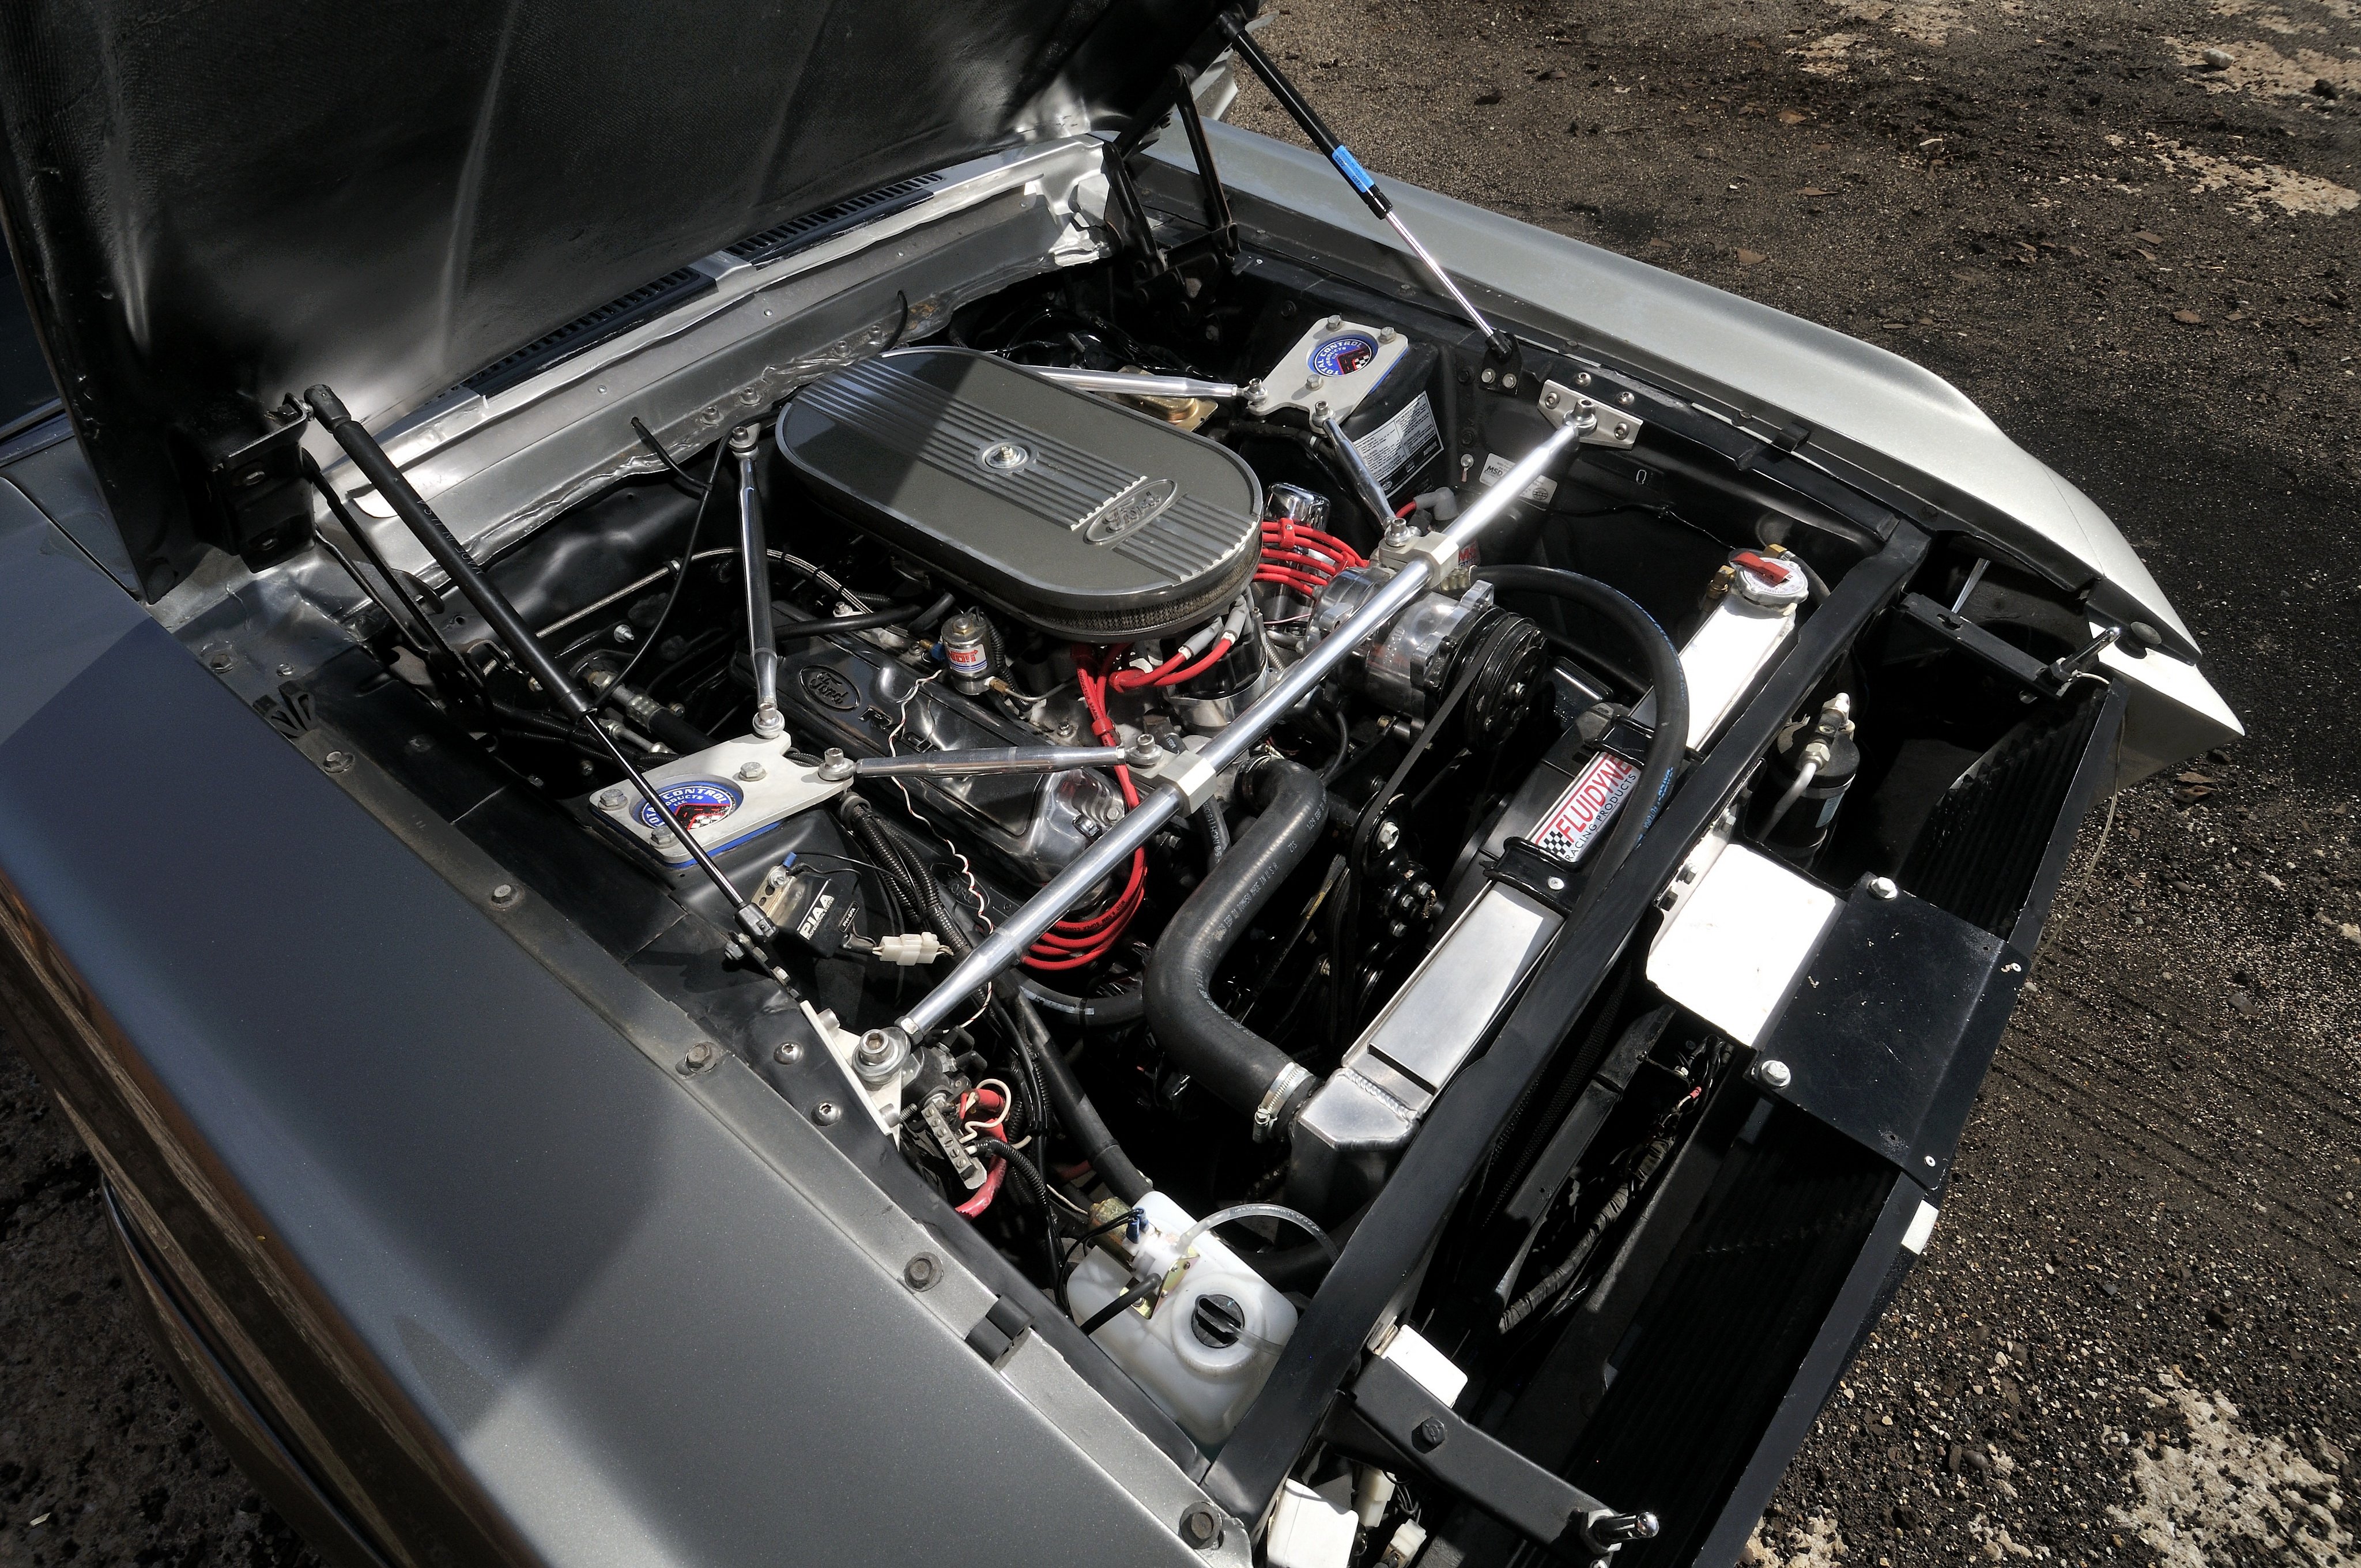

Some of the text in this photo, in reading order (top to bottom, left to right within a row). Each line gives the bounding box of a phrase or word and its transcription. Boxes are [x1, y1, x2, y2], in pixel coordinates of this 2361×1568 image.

[1317, 341, 1362, 375] TOTAL CONTROL
[1326, 346, 1347, 367] PRODUCTS
[1485, 465, 1503, 477] MSD
[1102, 491, 1161, 534] Ford
[808, 671, 849, 705] Ford
[646, 787, 728, 827] TOTA CONTROL
[1556, 756, 1632, 843] FLUIDYNE
[1210, 826, 1220, 844] INCH
[1564, 774, 1636, 862] RACING PRODUCTS
[1213, 845, 1222, 857] 5/8
[799, 894, 835, 940] PIAA
